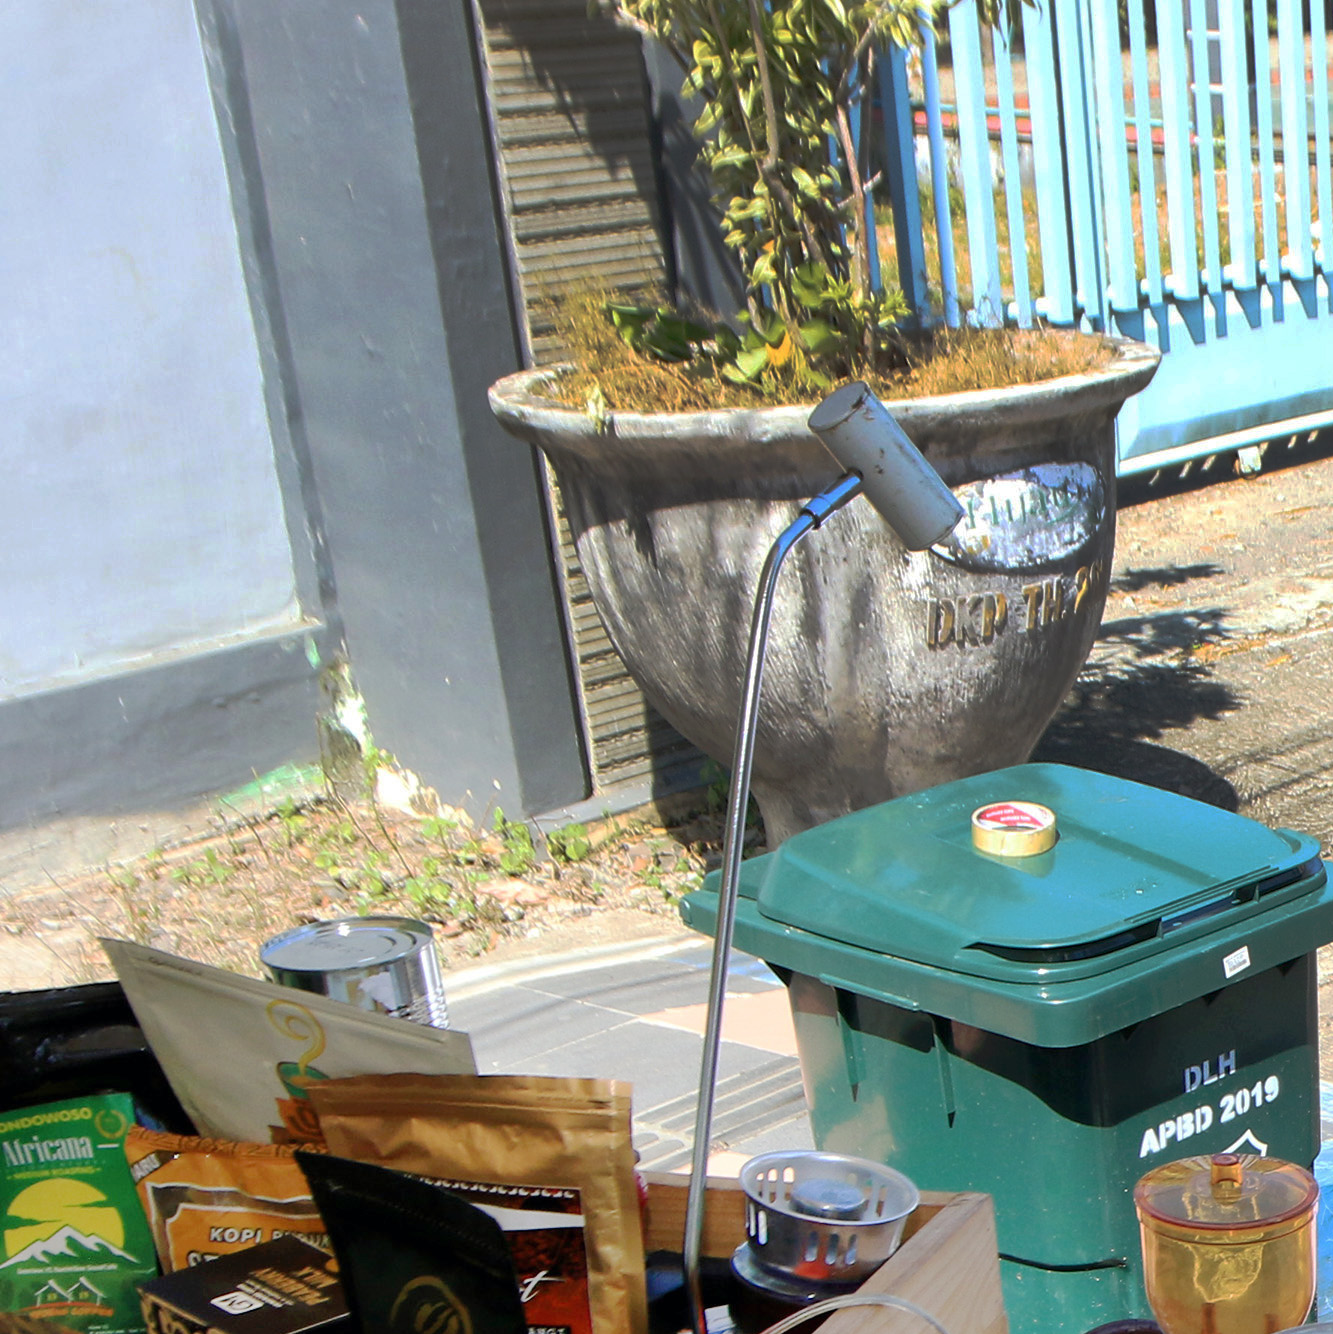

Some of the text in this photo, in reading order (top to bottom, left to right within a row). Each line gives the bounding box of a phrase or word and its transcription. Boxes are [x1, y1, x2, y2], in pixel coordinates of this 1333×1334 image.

[1182, 1050, 1236, 1094] DLH
[1139, 1075, 1280, 1158] APBD 2019
[209, 1226, 262, 1244] KOPI
